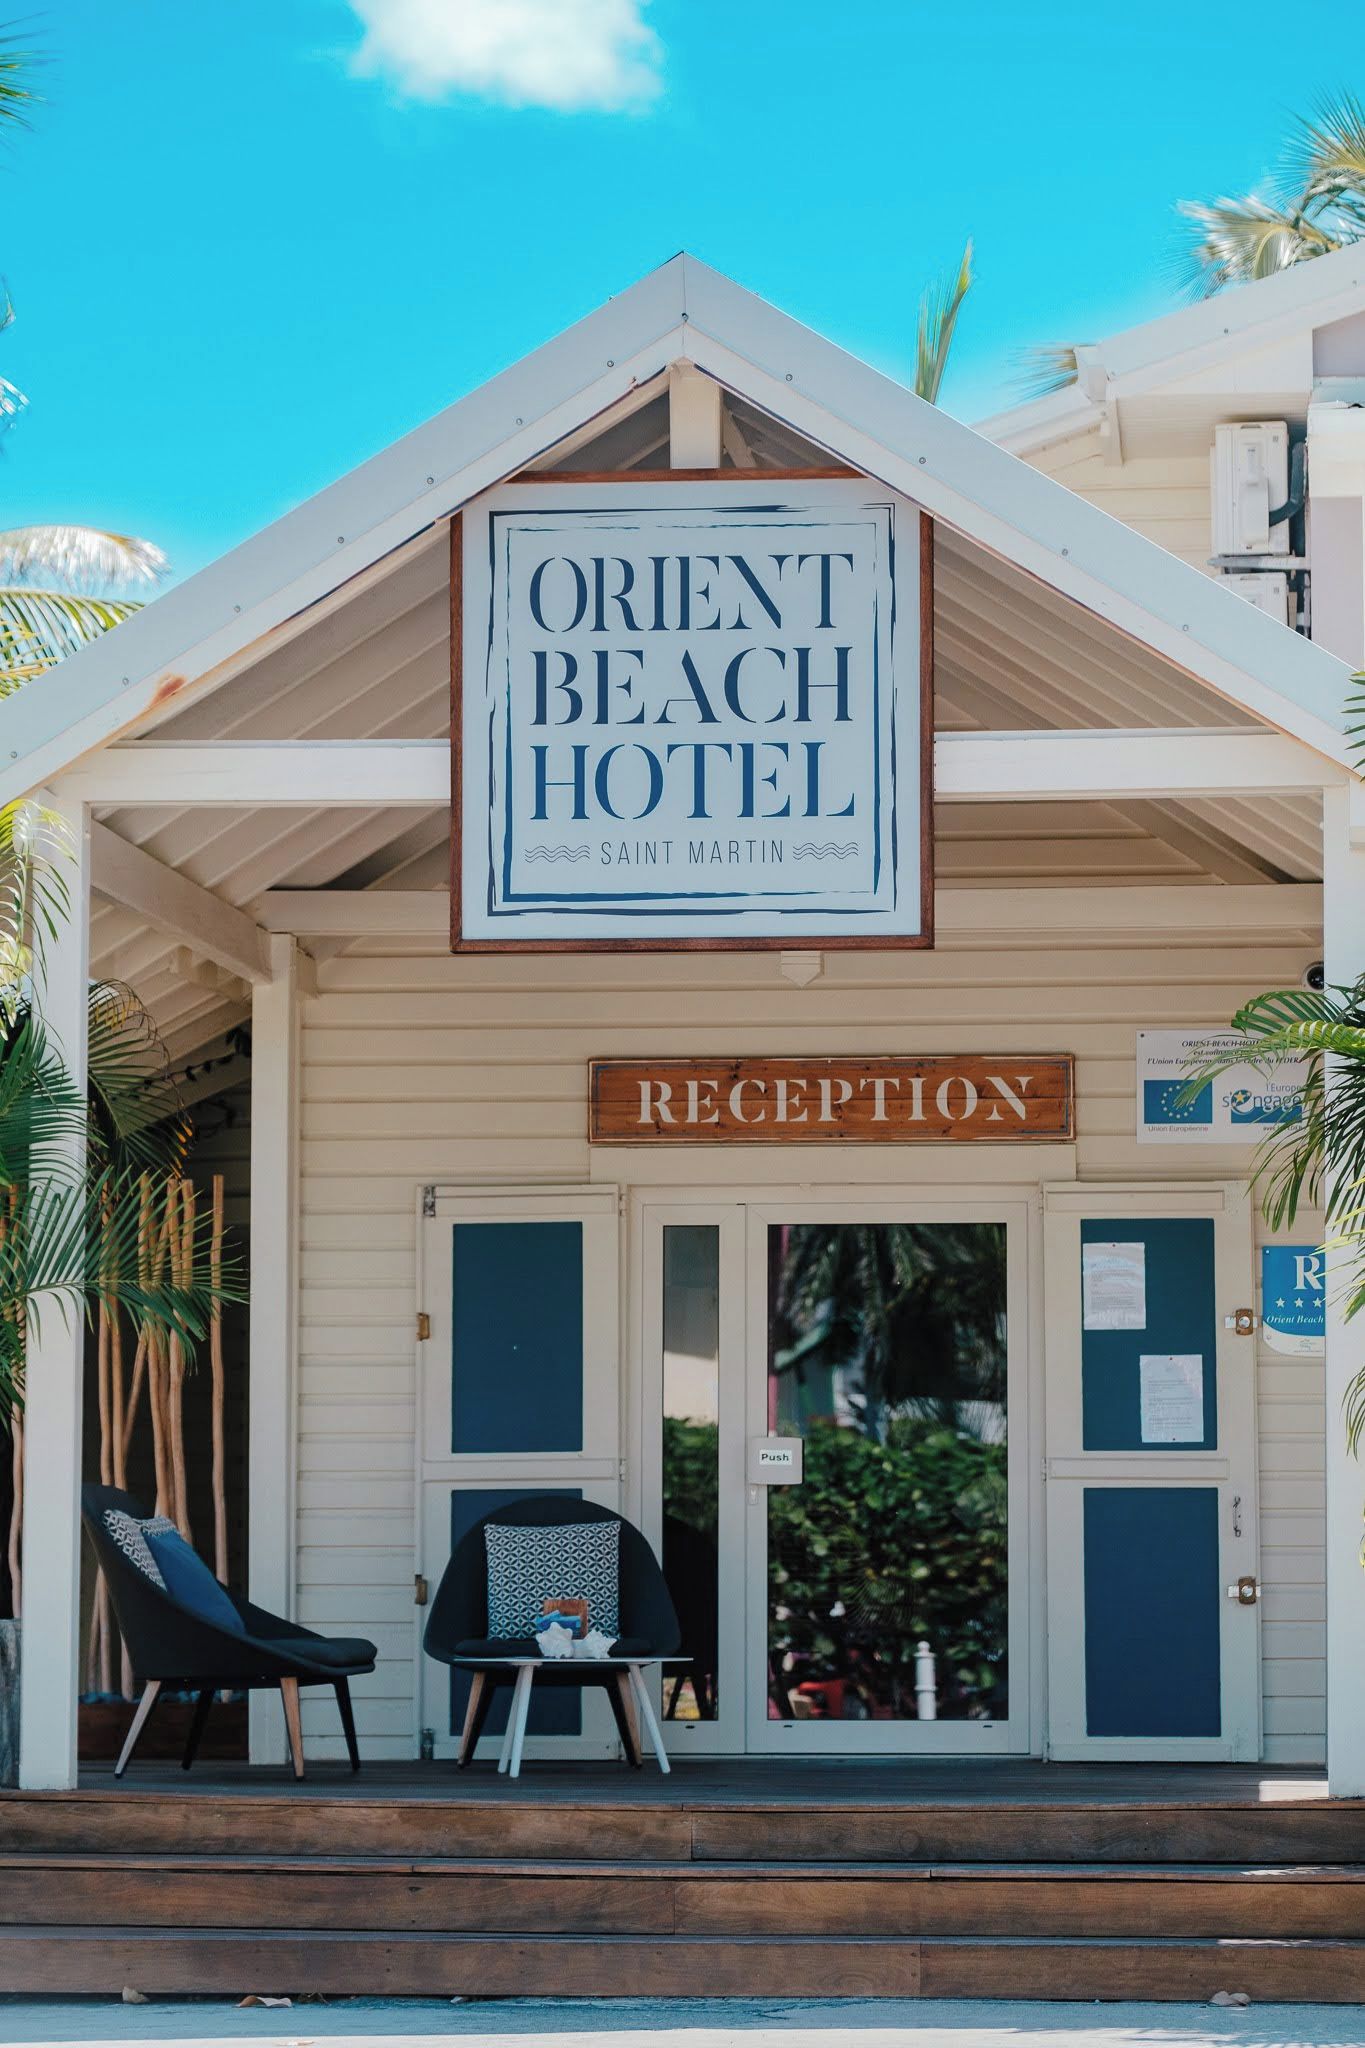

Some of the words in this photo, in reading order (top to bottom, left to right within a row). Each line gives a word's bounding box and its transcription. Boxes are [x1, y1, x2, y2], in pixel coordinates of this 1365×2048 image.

[529, 553, 854, 632] ORIENT
[530, 646, 854, 726] BEACH
[530, 741, 855, 820] HOTEL
[600, 841, 673, 865] SAINT
[688, 839, 784, 864] MARTIN
[636, 1076, 1035, 1124] RECEPTION
[1293, 1255, 1324, 1290] R
[1266, 1315, 1295, 1324] Orient
[1297, 1314, 1324, 1324] Beach
[761, 1453, 789, 1461] Push
